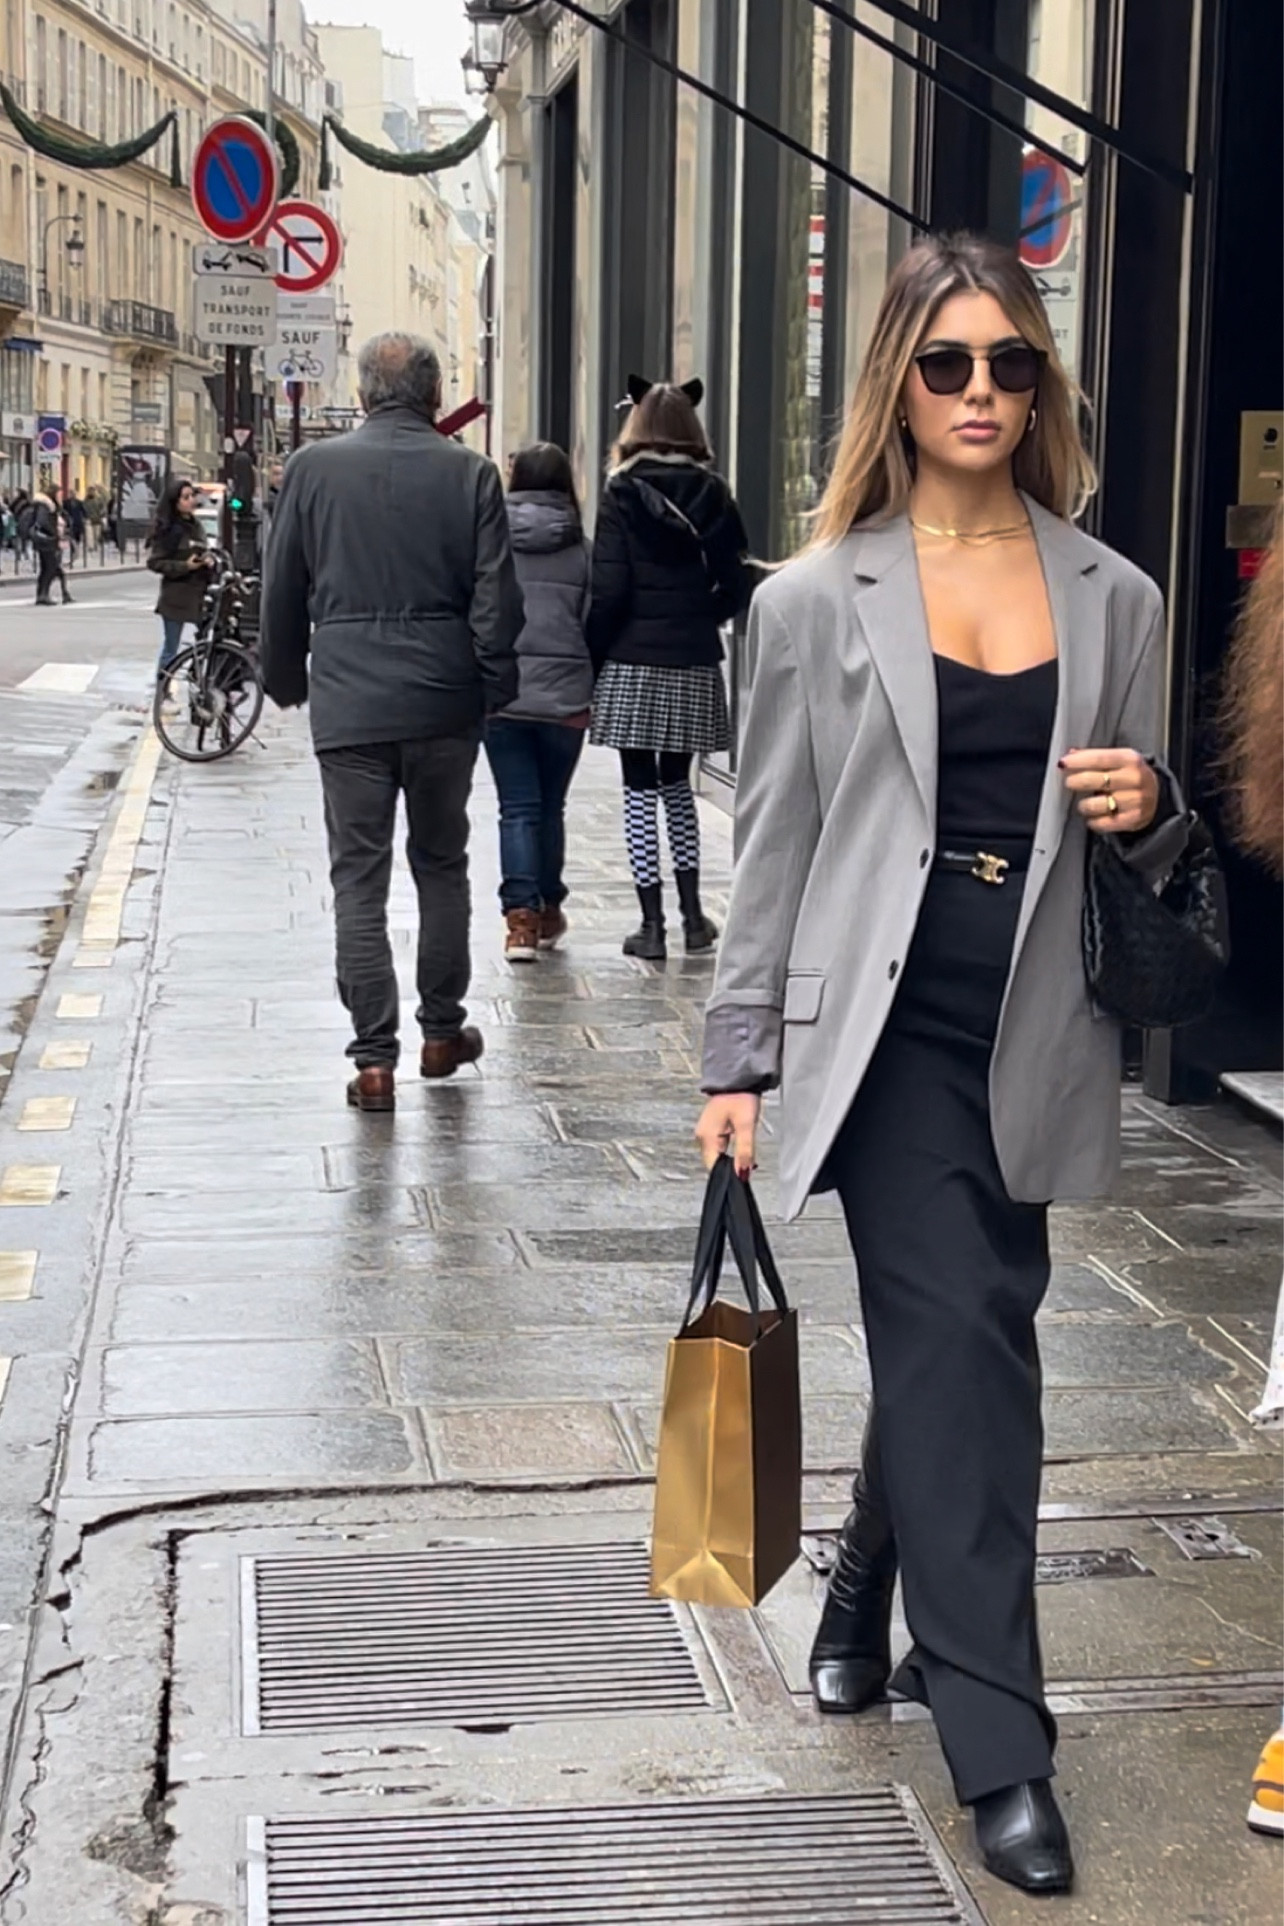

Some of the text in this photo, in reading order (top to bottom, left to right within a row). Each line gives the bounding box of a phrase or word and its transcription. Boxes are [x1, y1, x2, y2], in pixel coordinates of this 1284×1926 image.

[221, 285, 250, 297] SAUF
[203, 302, 270, 317] TRANSPORT
[208, 322, 264, 336] DE FONDS
[281, 331, 321, 344] SAUF
